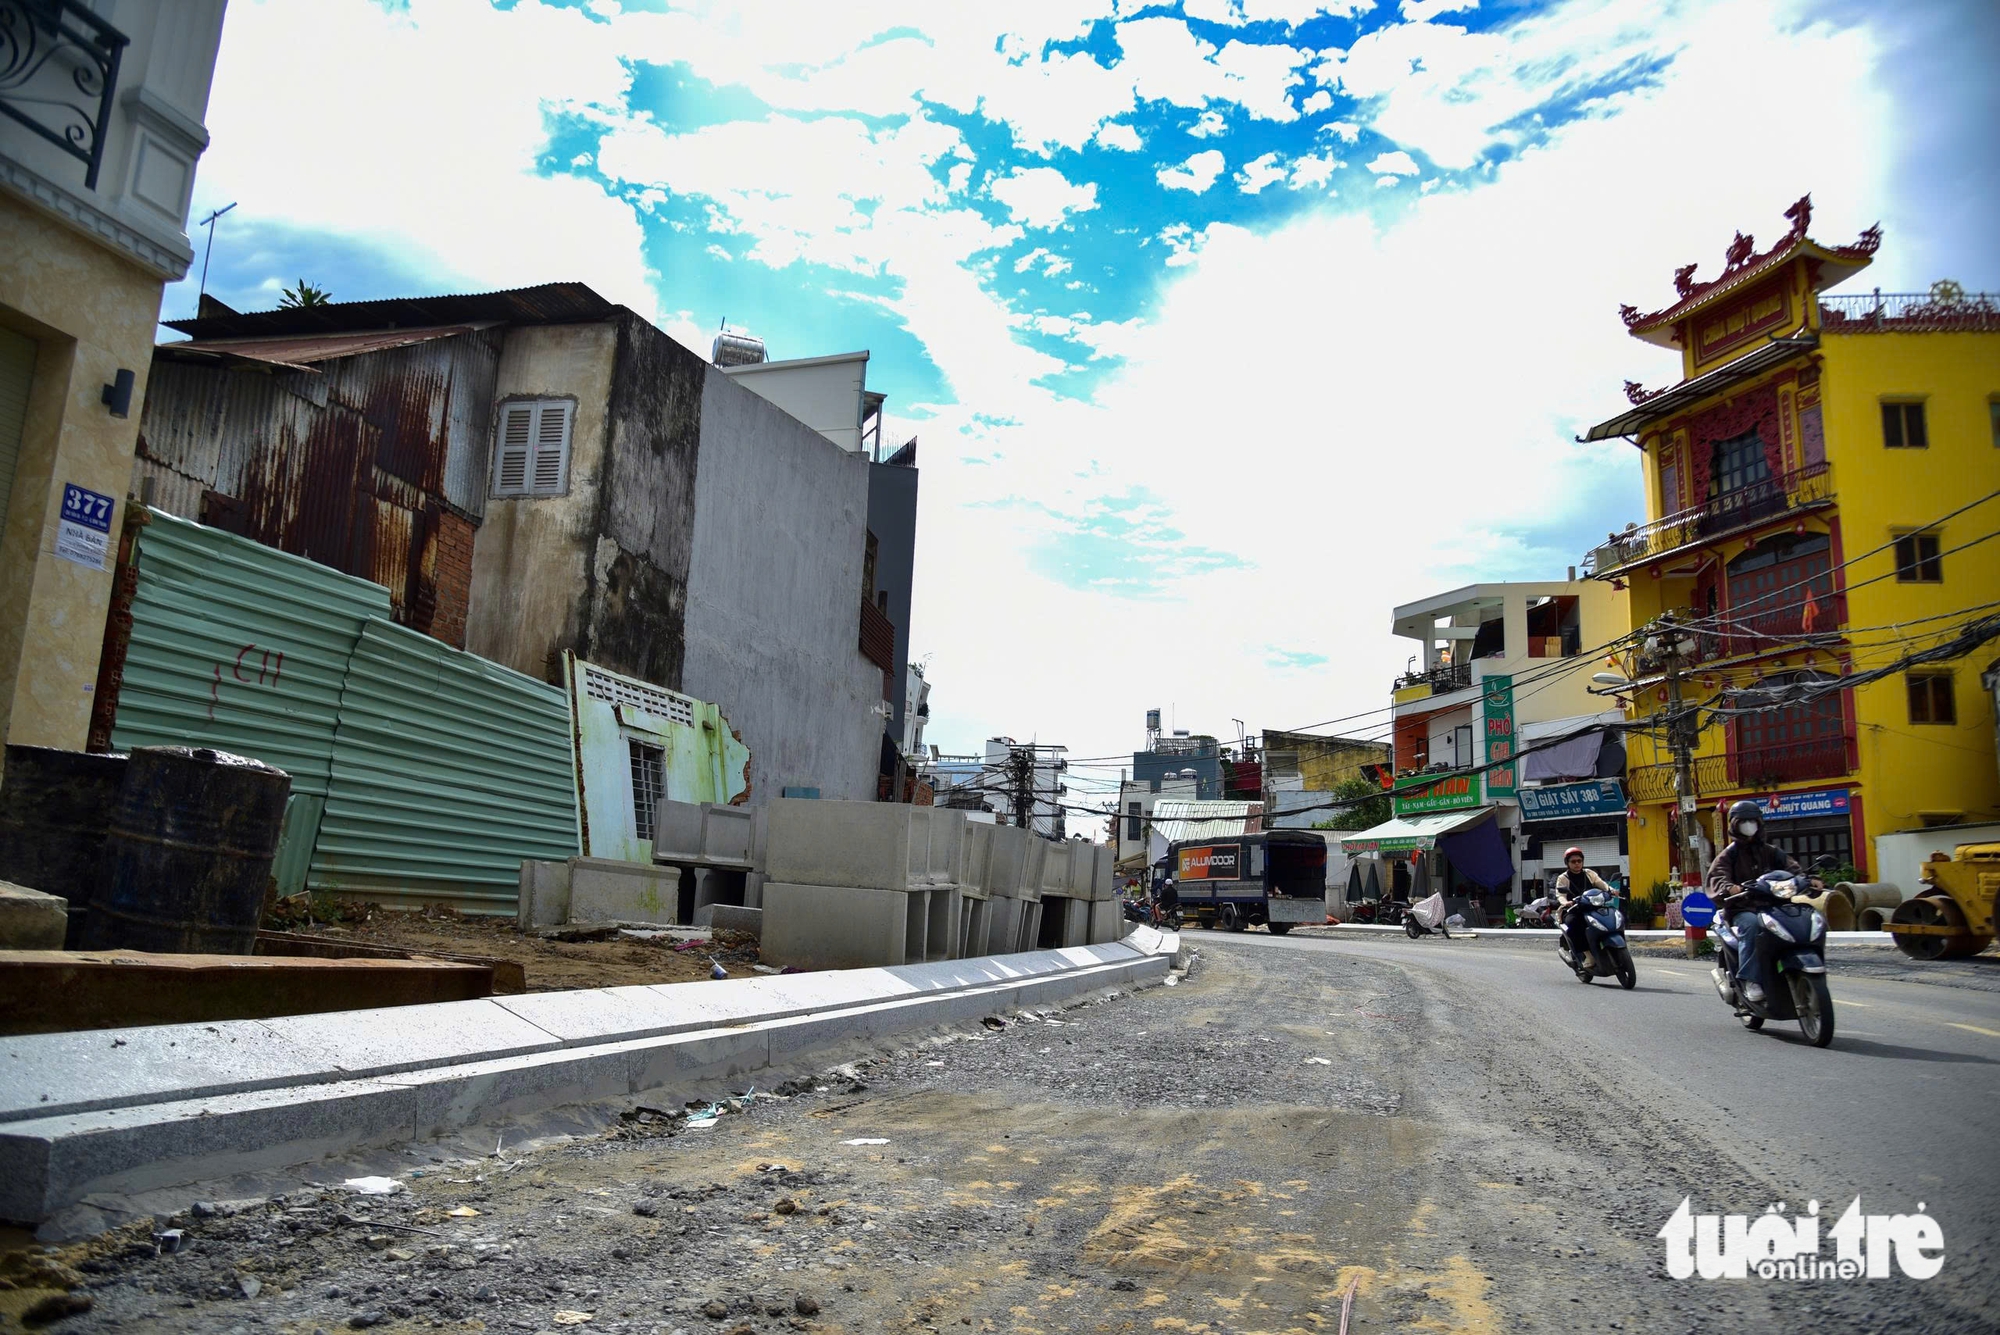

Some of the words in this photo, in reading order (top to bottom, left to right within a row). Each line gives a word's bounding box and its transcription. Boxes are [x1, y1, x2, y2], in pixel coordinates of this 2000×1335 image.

[67, 489, 110, 519] 377
[1488, 711, 1511, 735] PHỞ
[1538, 791, 1559, 808] GIẶT
[1560, 787, 1579, 805] SẤY
[1580, 788, 1600, 803] 388
[1801, 800, 1831, 811] QUANG
